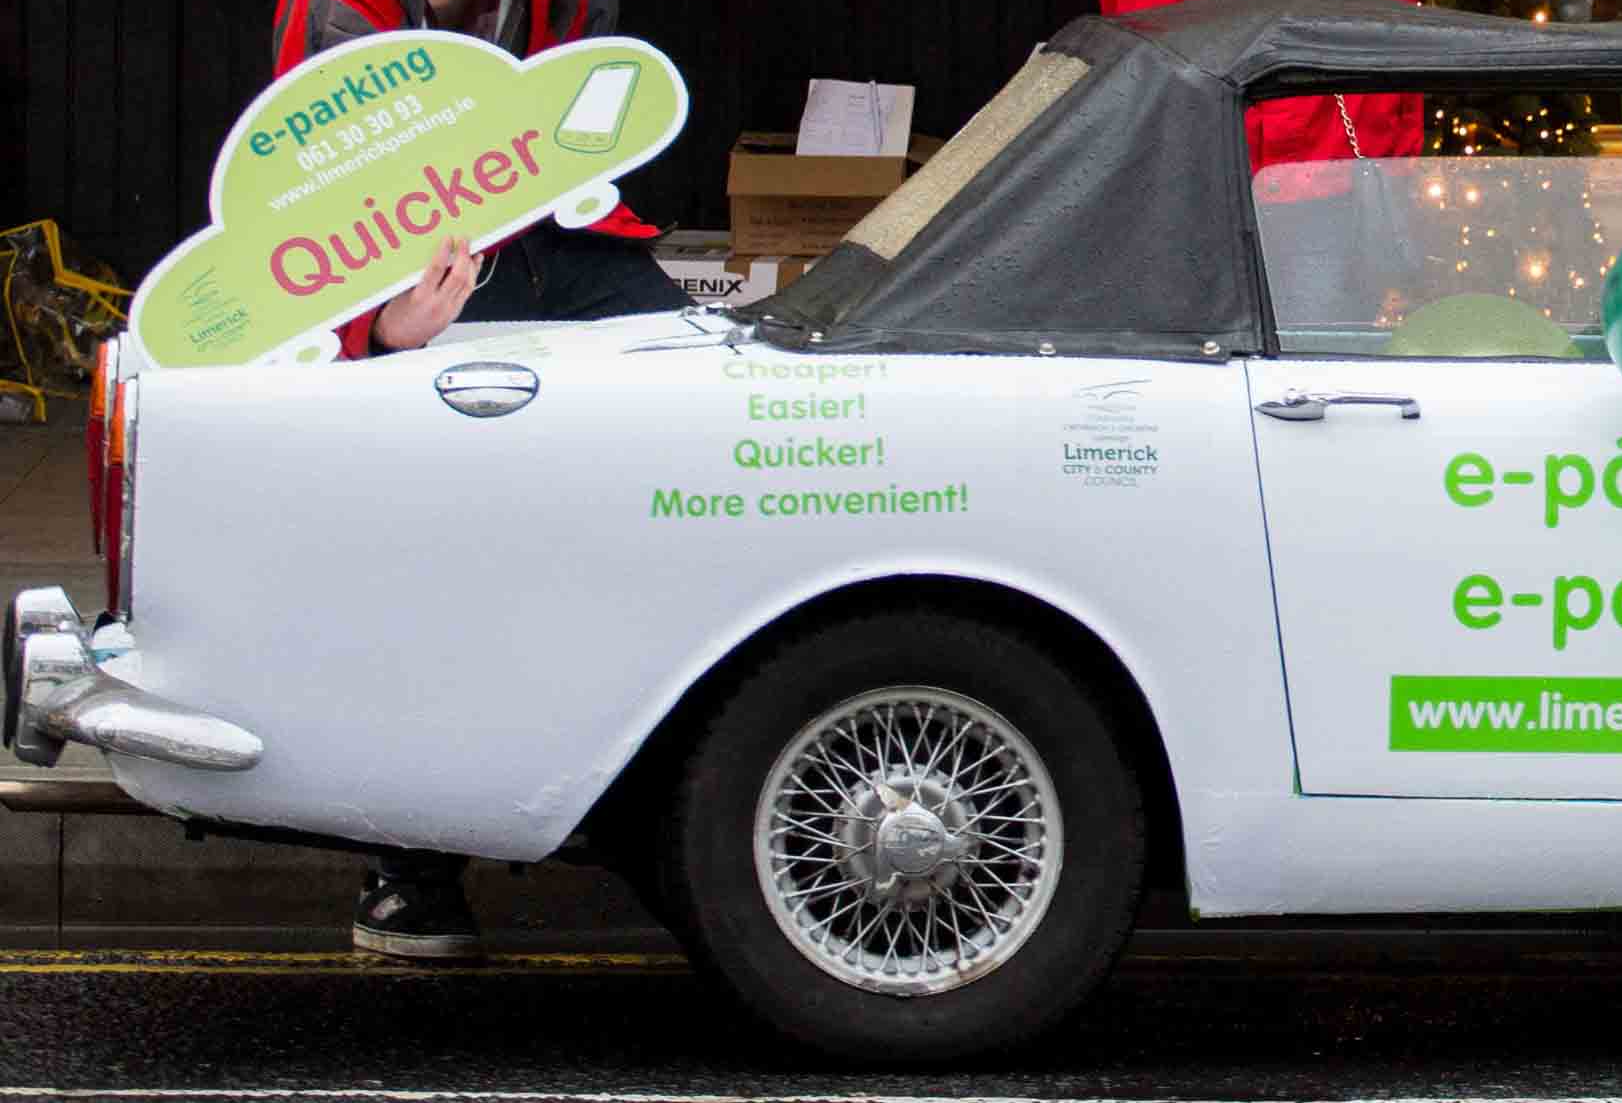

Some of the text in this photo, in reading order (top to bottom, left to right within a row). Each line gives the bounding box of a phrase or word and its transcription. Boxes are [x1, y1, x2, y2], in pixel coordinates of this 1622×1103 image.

[250, 47, 437, 156] e-parking
[296, 94, 423, 171] 061 30 30 93
[267, 96, 477, 212] www.limerickparking.ie
[270, 129, 540, 297] Quicker
[722, 360, 888, 385] Cheaper!
[747, 393, 866, 422] Easier!
[733, 437, 886, 469] Quicker!
[1063, 442, 1159, 461] Limerick
[650, 483, 969, 518] More convenient!
